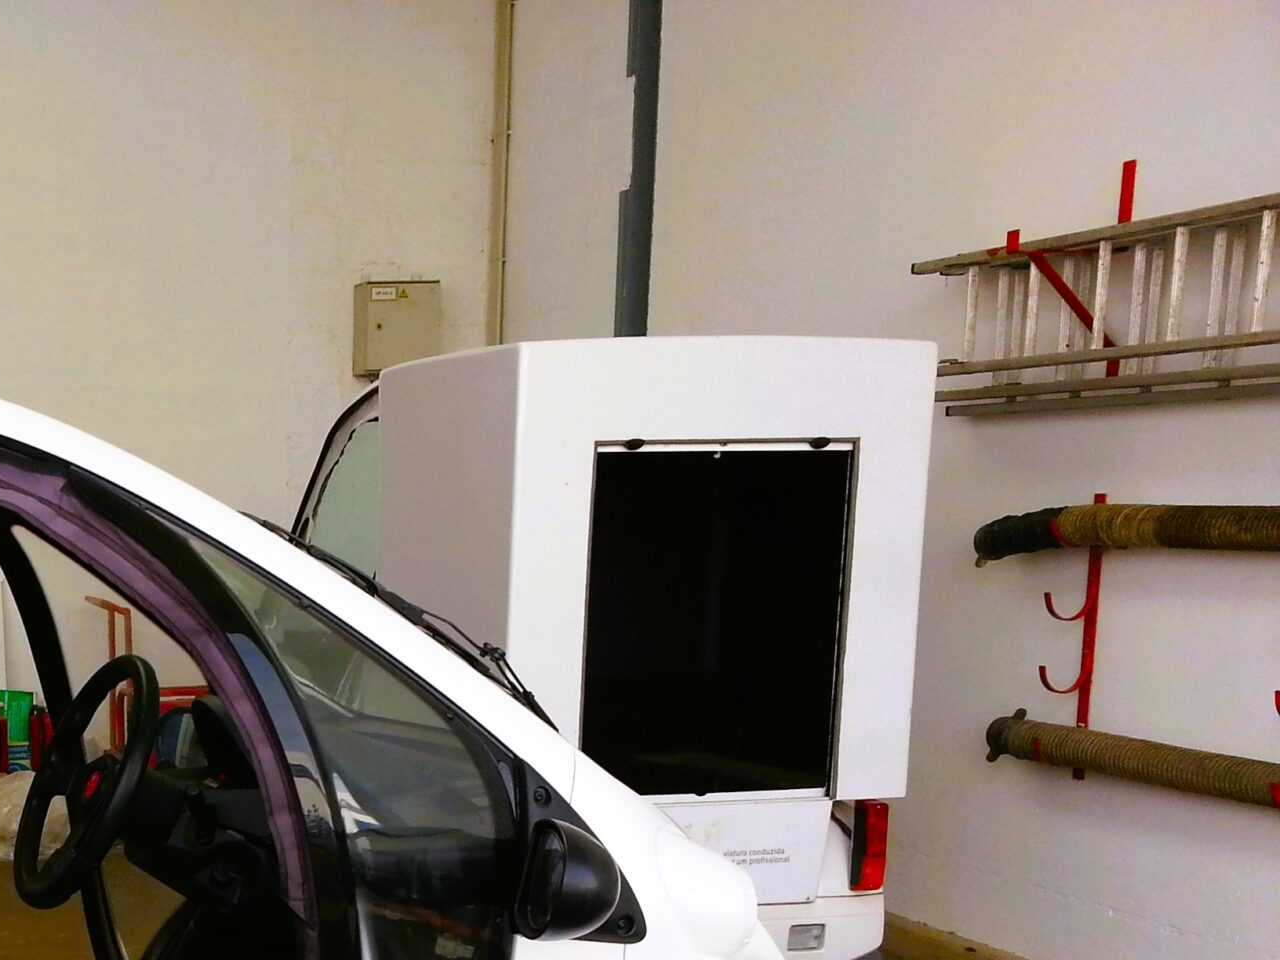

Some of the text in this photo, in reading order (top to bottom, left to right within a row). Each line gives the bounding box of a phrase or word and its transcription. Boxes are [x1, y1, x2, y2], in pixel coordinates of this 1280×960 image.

[723, 848, 785, 857] viatura conduzida
[749, 856, 790, 866] profissional
